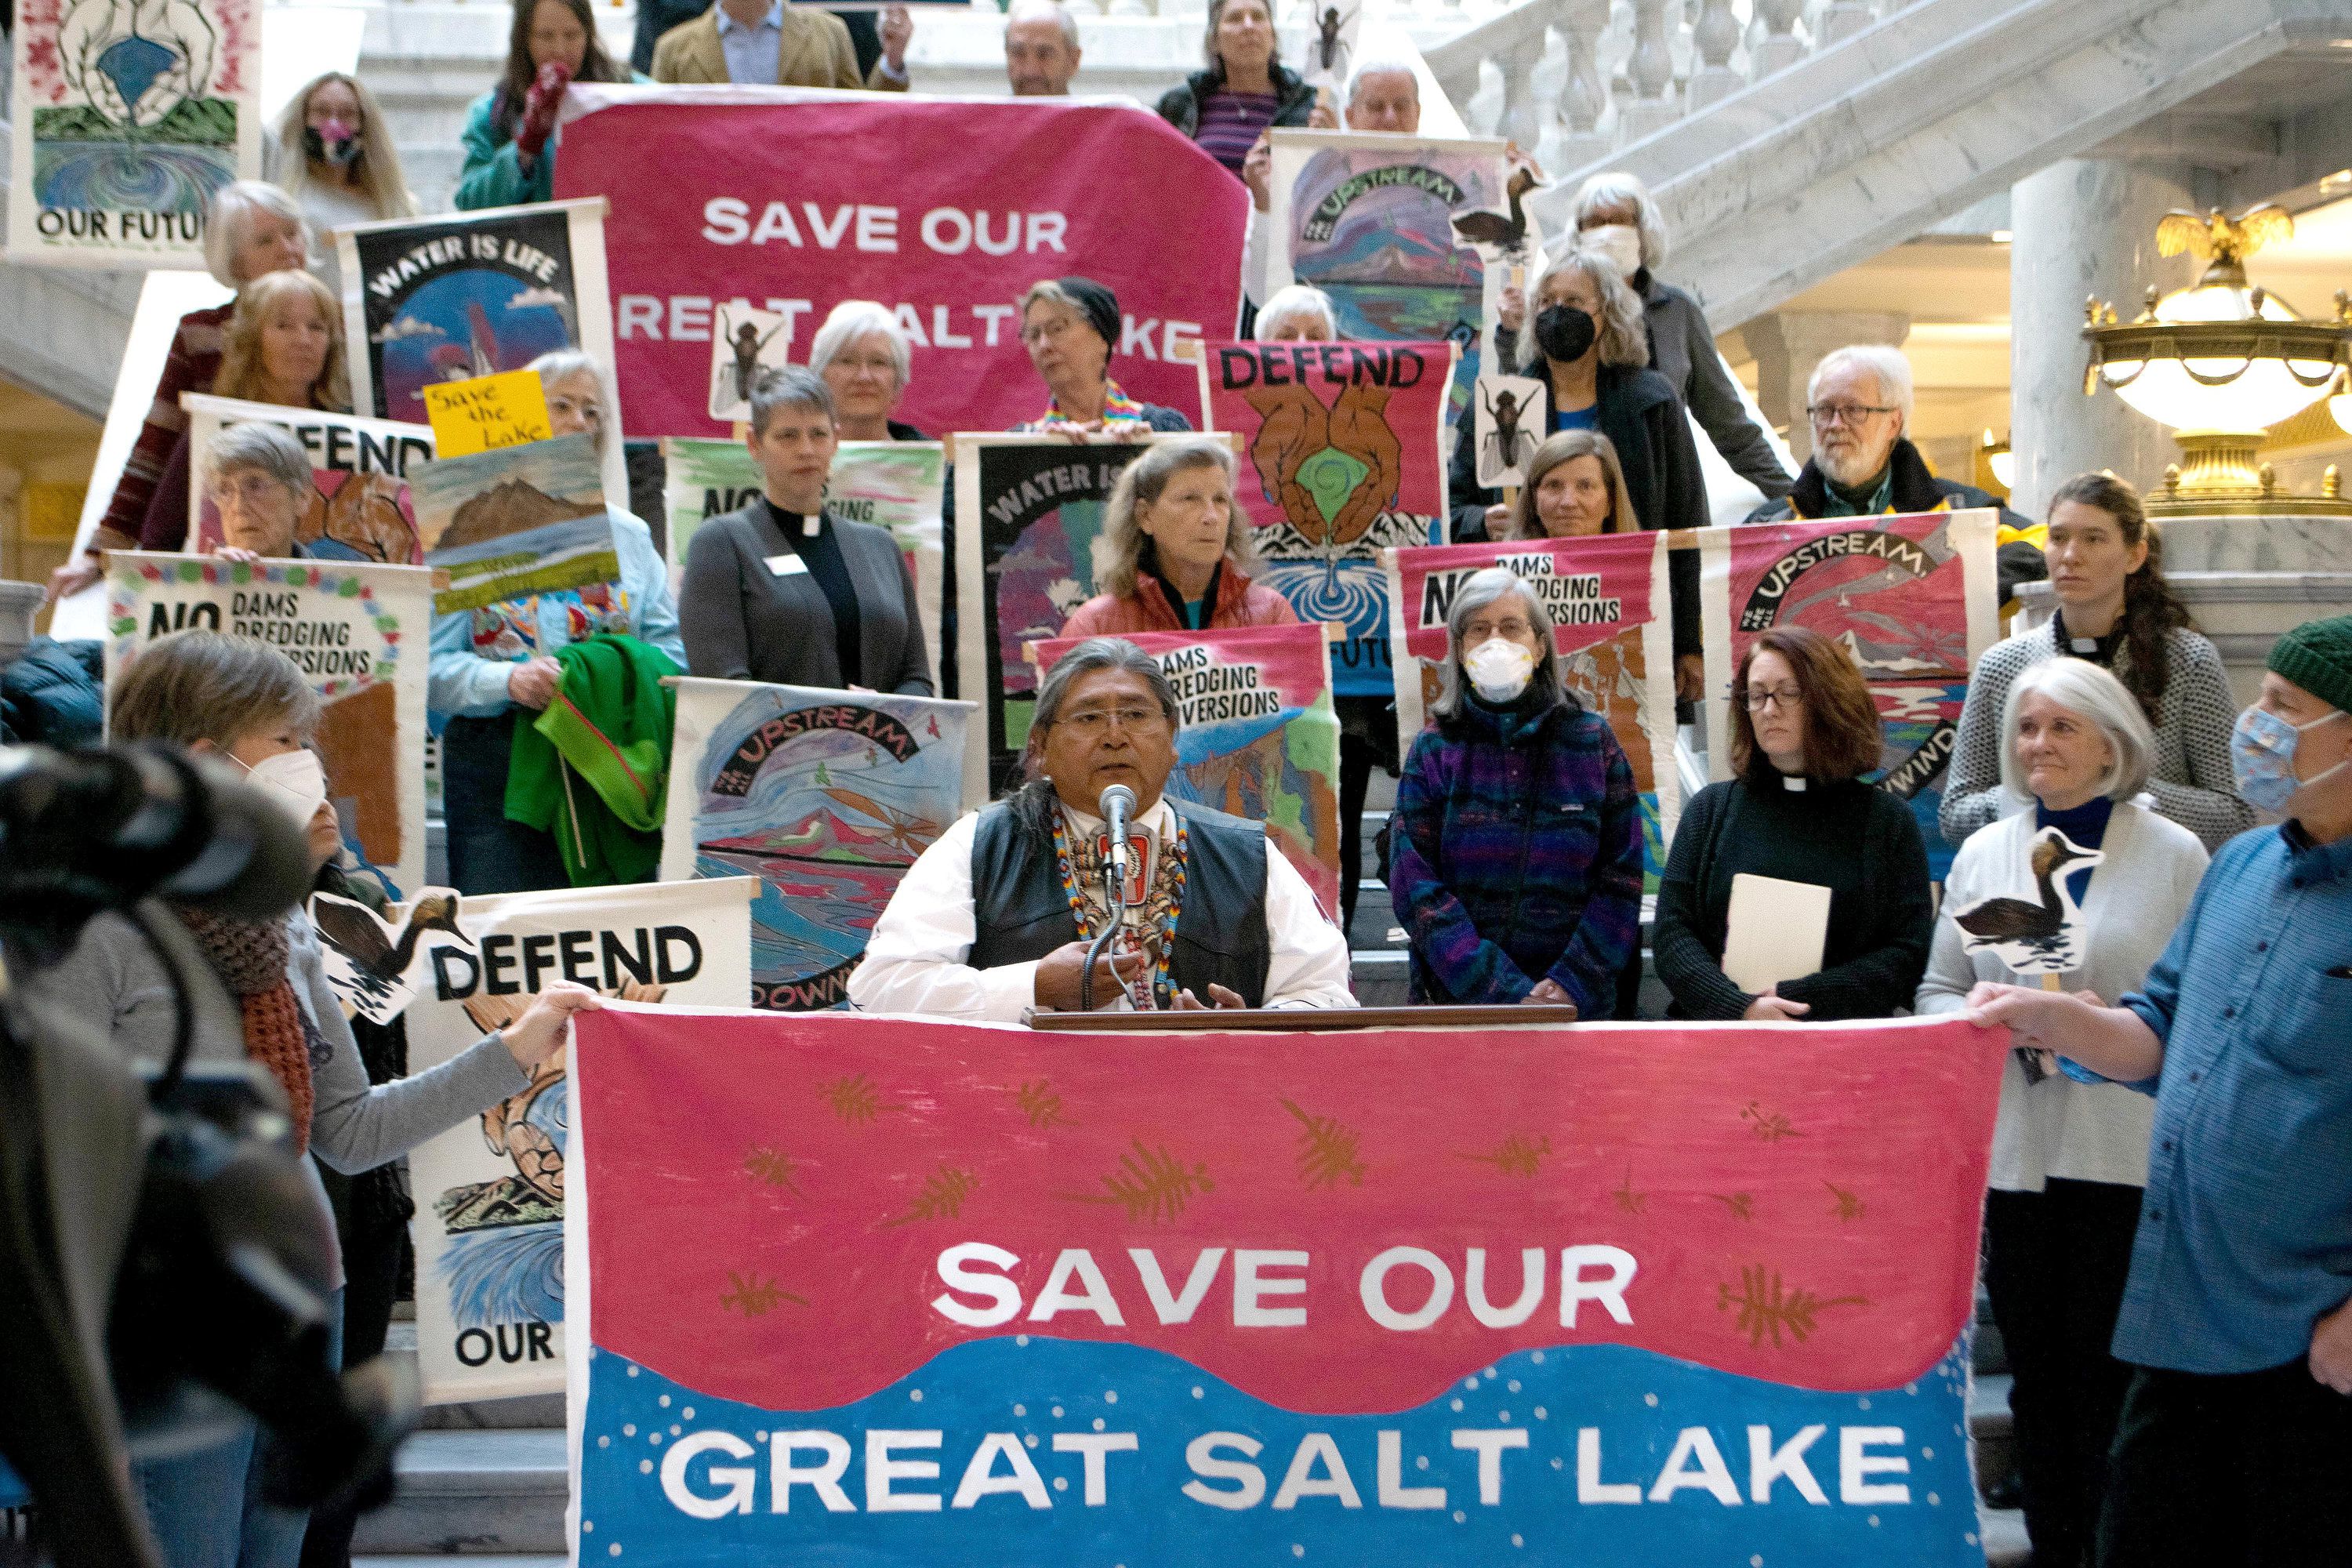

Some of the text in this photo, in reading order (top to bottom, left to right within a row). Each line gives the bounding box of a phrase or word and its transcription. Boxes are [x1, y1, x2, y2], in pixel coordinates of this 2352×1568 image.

[38, 209, 205, 241] OUR FUTU
[702, 197, 1068, 256] SAVE OUR
[368, 234, 560, 298] WATER IS LIFE
[618, 294, 1203, 366] RET ALT KE
[1220, 346, 1425, 390] DEFEND
[430, 383, 500, 412] Save
[467, 403, 512, 423] the
[218, 418, 432, 478] FEND
[987, 464, 1093, 524] WATER
[231, 592, 299, 618] DAMS
[1423, 571, 1478, 625] N
[1530, 576, 1600, 600] DGING
[234, 621, 351, 647] DREDGING
[1547, 601, 1620, 625] RSIONS
[282, 649, 371, 674] RSIONS
[1151, 648, 1208, 676] AMS
[1170, 666, 1258, 702] REDGING
[1177, 691, 1280, 726] VERSIONS
[1883, 728, 1957, 793] WIND
[430, 925, 702, 1001] DEFEND
[931, 1242, 1638, 1331] SAVE OUR
[455, 1321, 555, 1367] OUR
[660, 1425, 1911, 1519] GREAT SALT LAKE
